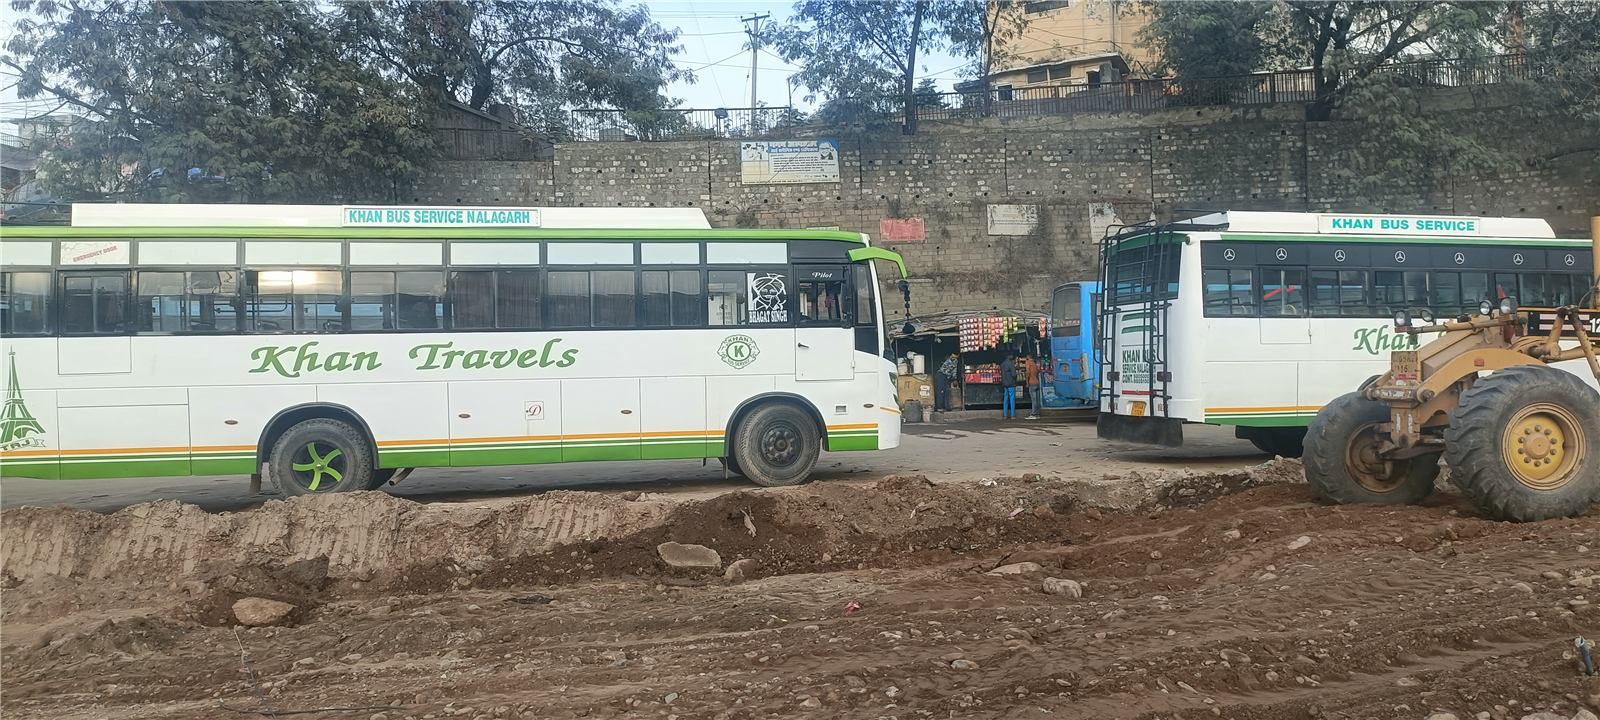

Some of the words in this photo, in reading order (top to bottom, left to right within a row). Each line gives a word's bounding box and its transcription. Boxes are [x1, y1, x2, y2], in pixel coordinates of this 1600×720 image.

[350, 210, 382, 223] KHAN
[387, 210, 410, 223] BUS
[414, 210, 463, 223] SERVICE
[467, 211, 530, 223] NALAGARH
[1332, 218, 1373, 229] KHAN
[1381, 219, 1409, 230] BUS
[1416, 220, 1475, 231] SERVICE
[812, 271, 833, 279] Pilot
[748, 310, 770, 323] BHAGAT
[771, 309, 788, 322] SINGH
[1353, 325, 1421, 355] Khan
[249, 341, 383, 378] Khan
[408, 338, 579, 371] Travels
[734, 345, 745, 358] K
[1122, 349, 1141, 363] KHAN
